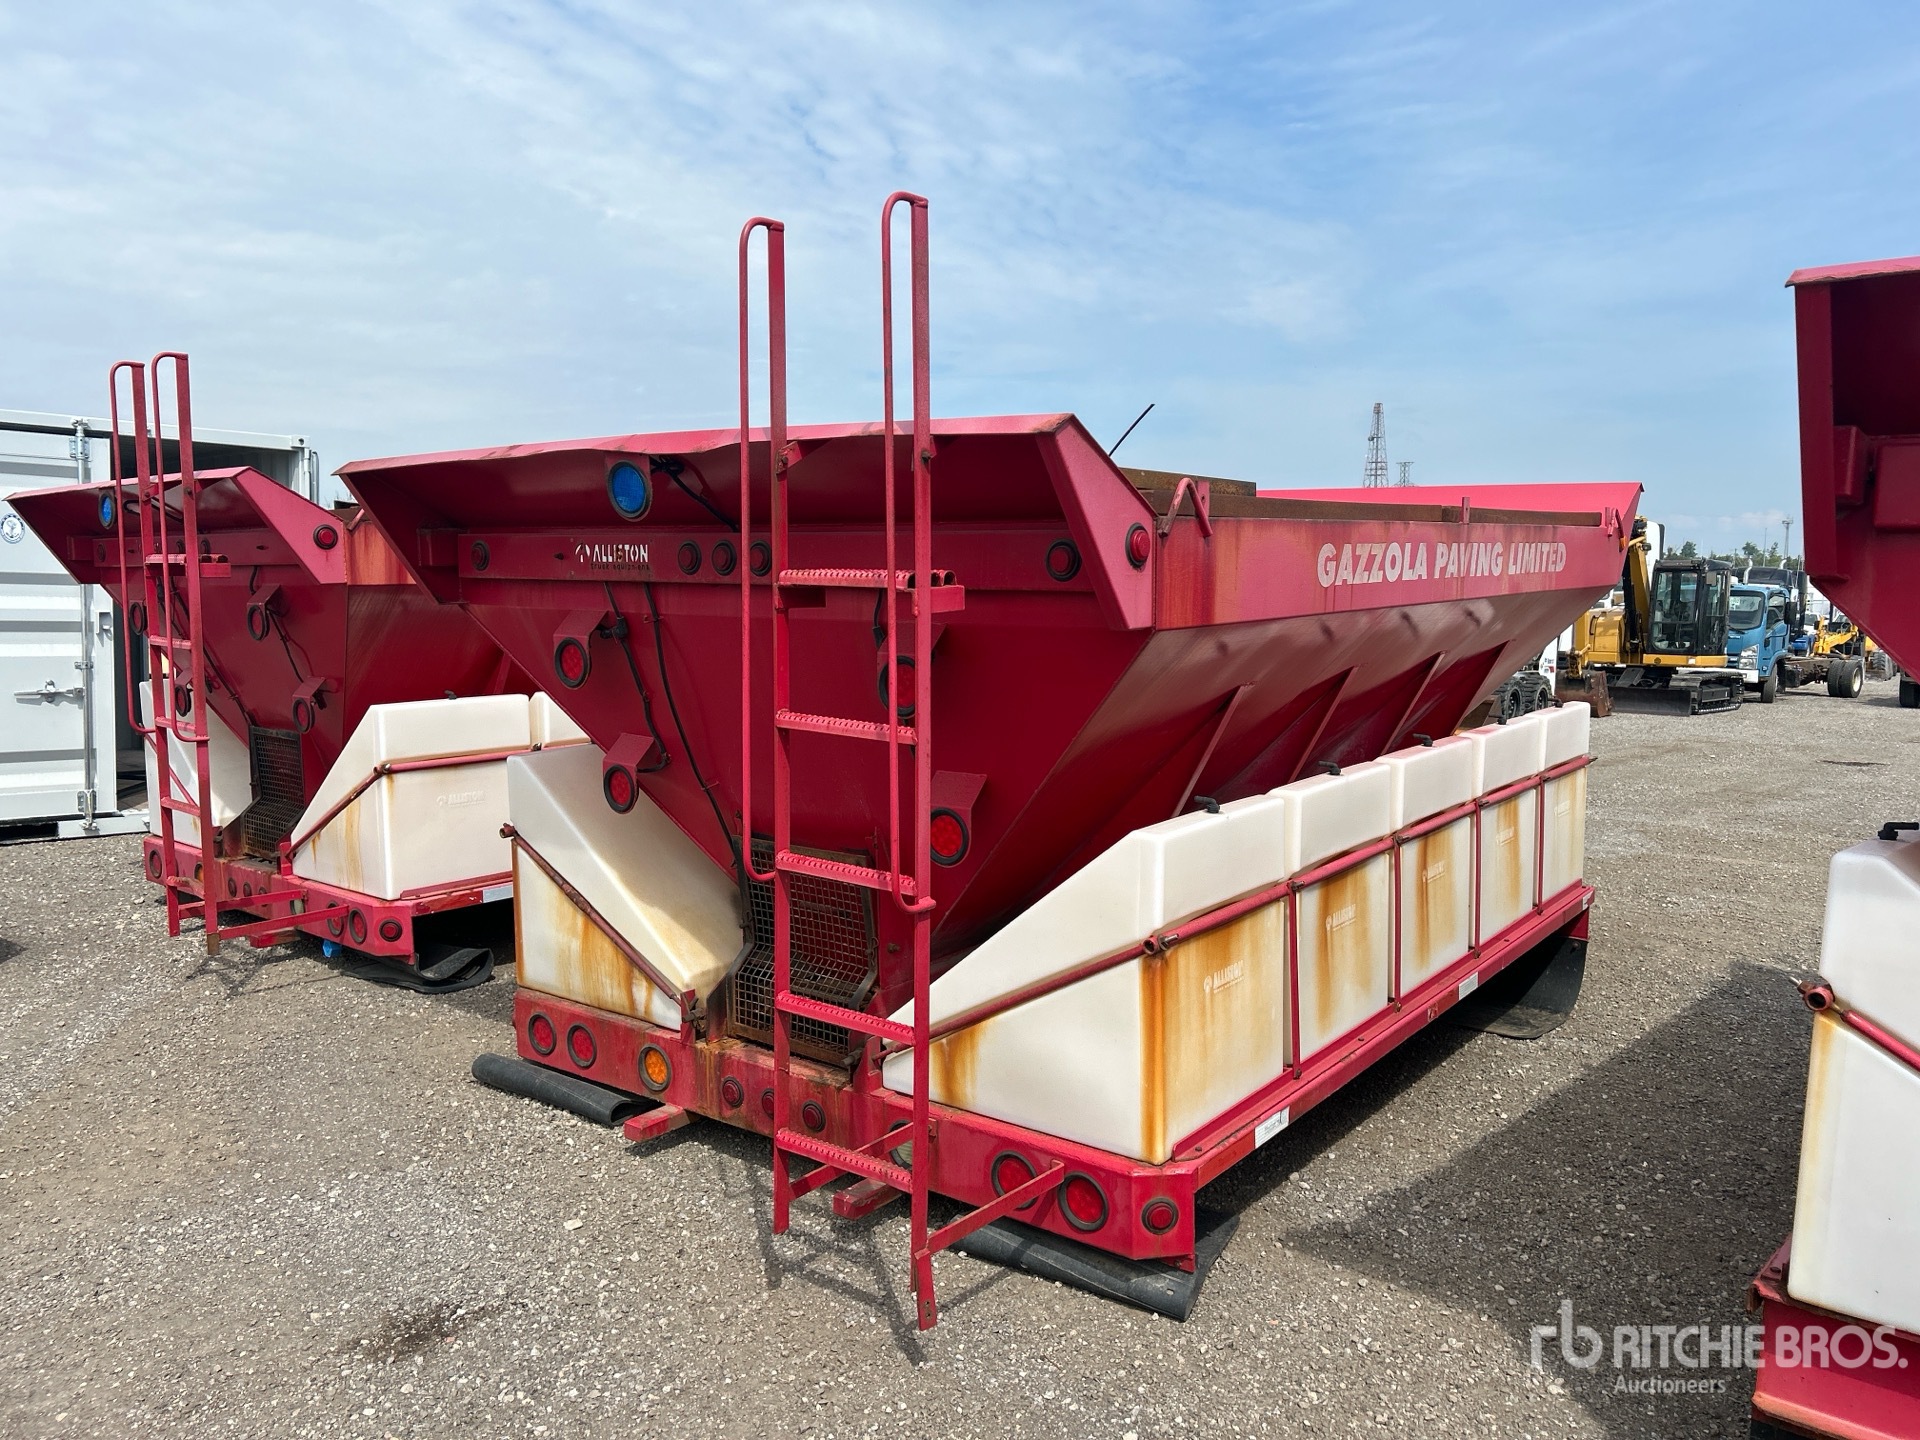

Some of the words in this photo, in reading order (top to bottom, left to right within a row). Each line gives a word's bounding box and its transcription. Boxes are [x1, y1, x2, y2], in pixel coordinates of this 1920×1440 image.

[593, 544, 648, 563] ALLISTON
[1317, 542, 1427, 588] GAZZOLA
[1434, 542, 1503, 579] PAVING
[1508, 542, 1567, 575] LIMITED
